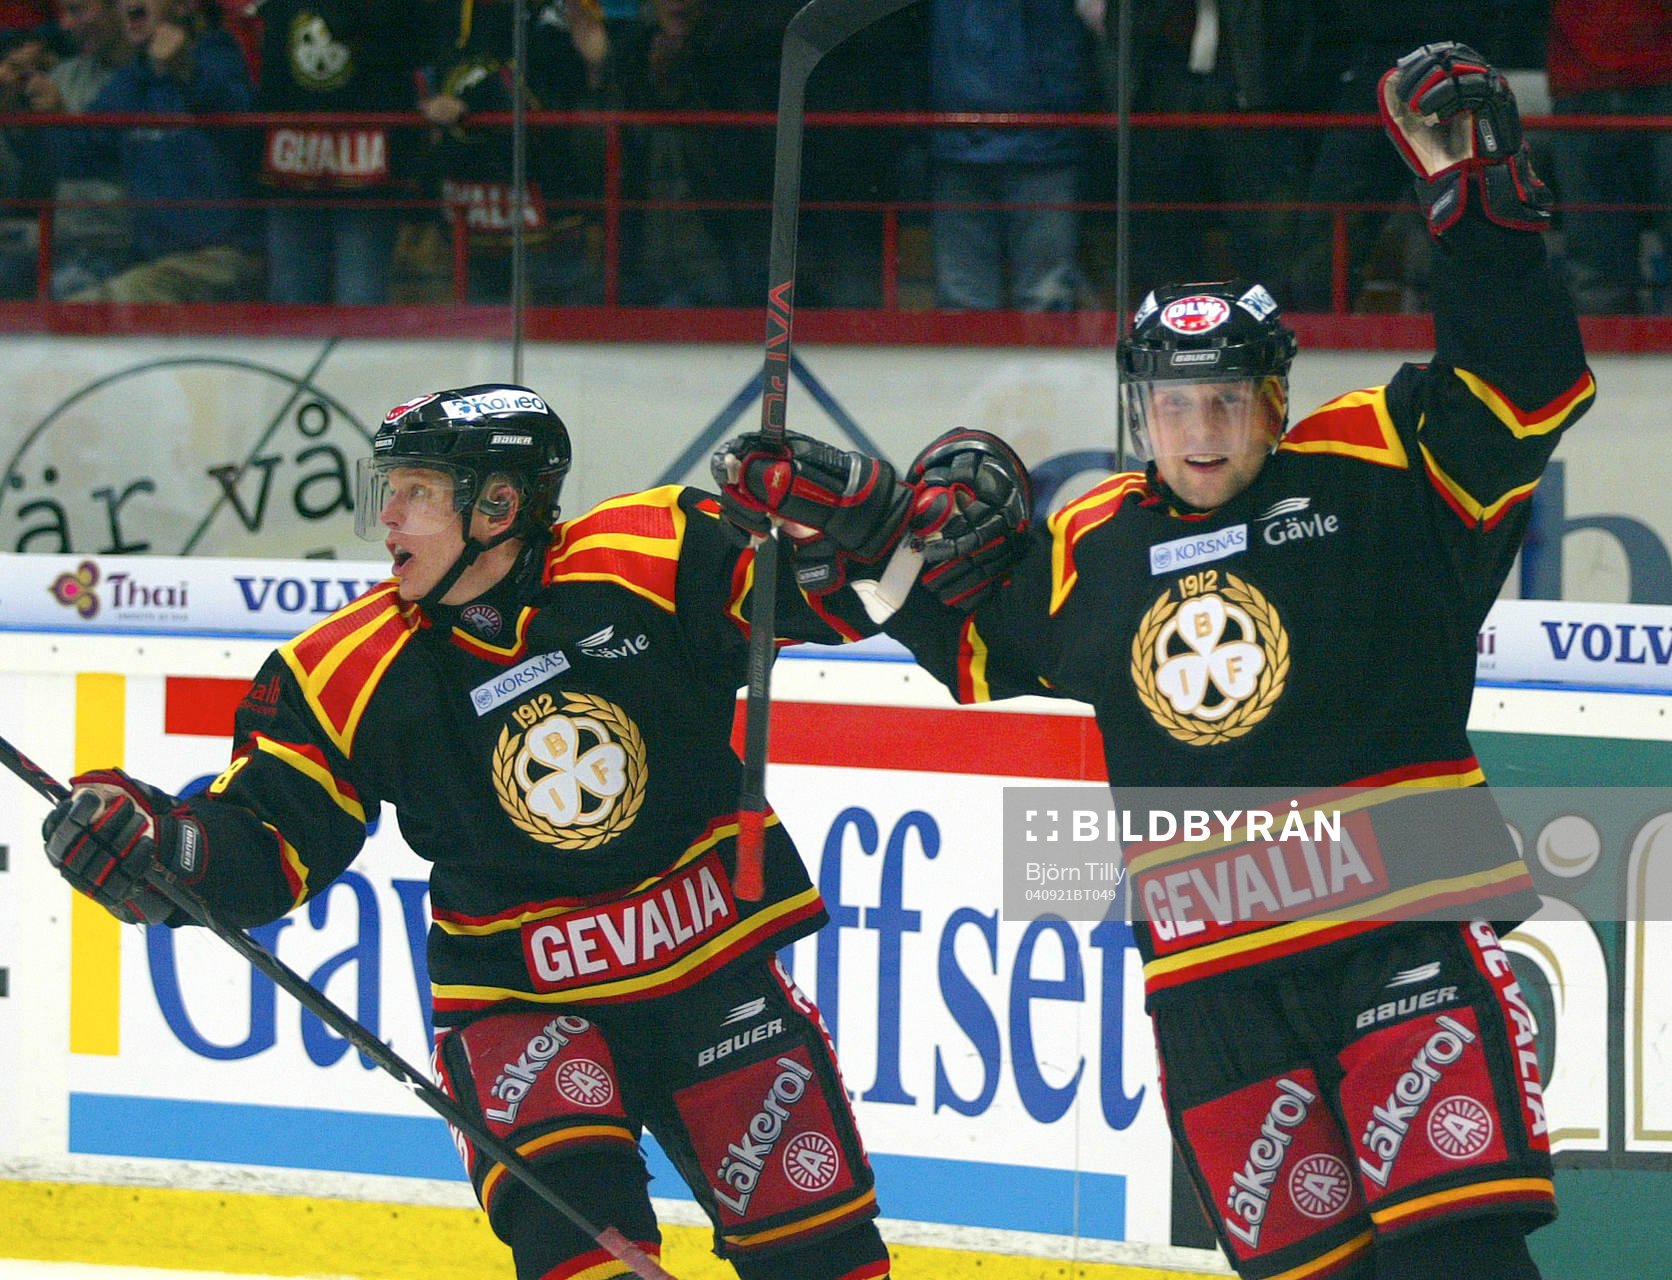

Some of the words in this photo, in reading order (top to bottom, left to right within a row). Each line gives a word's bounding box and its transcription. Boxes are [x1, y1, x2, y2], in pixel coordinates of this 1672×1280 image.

[1175, 353, 1217, 363] BAUER
[491, 434, 534, 445] BAUER
[1175, 530, 1245, 561] KORSNÄS
[1263, 513, 1339, 546] Gävle
[107, 572, 189, 608] Thai
[234, 576, 381, 613] VOLV
[1178, 569, 1219, 599] 1912
[1194, 612, 1213, 639] B
[1541, 621, 1672, 665] VOLV
[581, 634, 650, 659] Gävle
[494, 651, 564, 698] KORSNÄS
[1226, 656, 1243, 684] F
[512, 693, 557, 730] 1912
[542, 731, 569, 757] B
[591, 758, 612, 785] F
[1143, 825, 1374, 942] GEVALIA
[530, 866, 729, 982] GEVALIA
[780, 806, 1146, 1131] ffset
[1356, 985, 1455, 1028] BAUER
[698, 1018, 783, 1067] BAUER
[1470, 918, 1549, 1137] GEVALIA
[486, 1014, 590, 1124] Läkero
[573, 1066, 604, 1099] A
[1359, 1015, 1476, 1188] Läkerol
[714, 1057, 814, 1216] Läkerol
[1441, 1111, 1482, 1145] A
[795, 1146, 828, 1180] A
[1225, 1078, 1316, 1248] Läkerol
[1302, 1173, 1340, 1202] A
